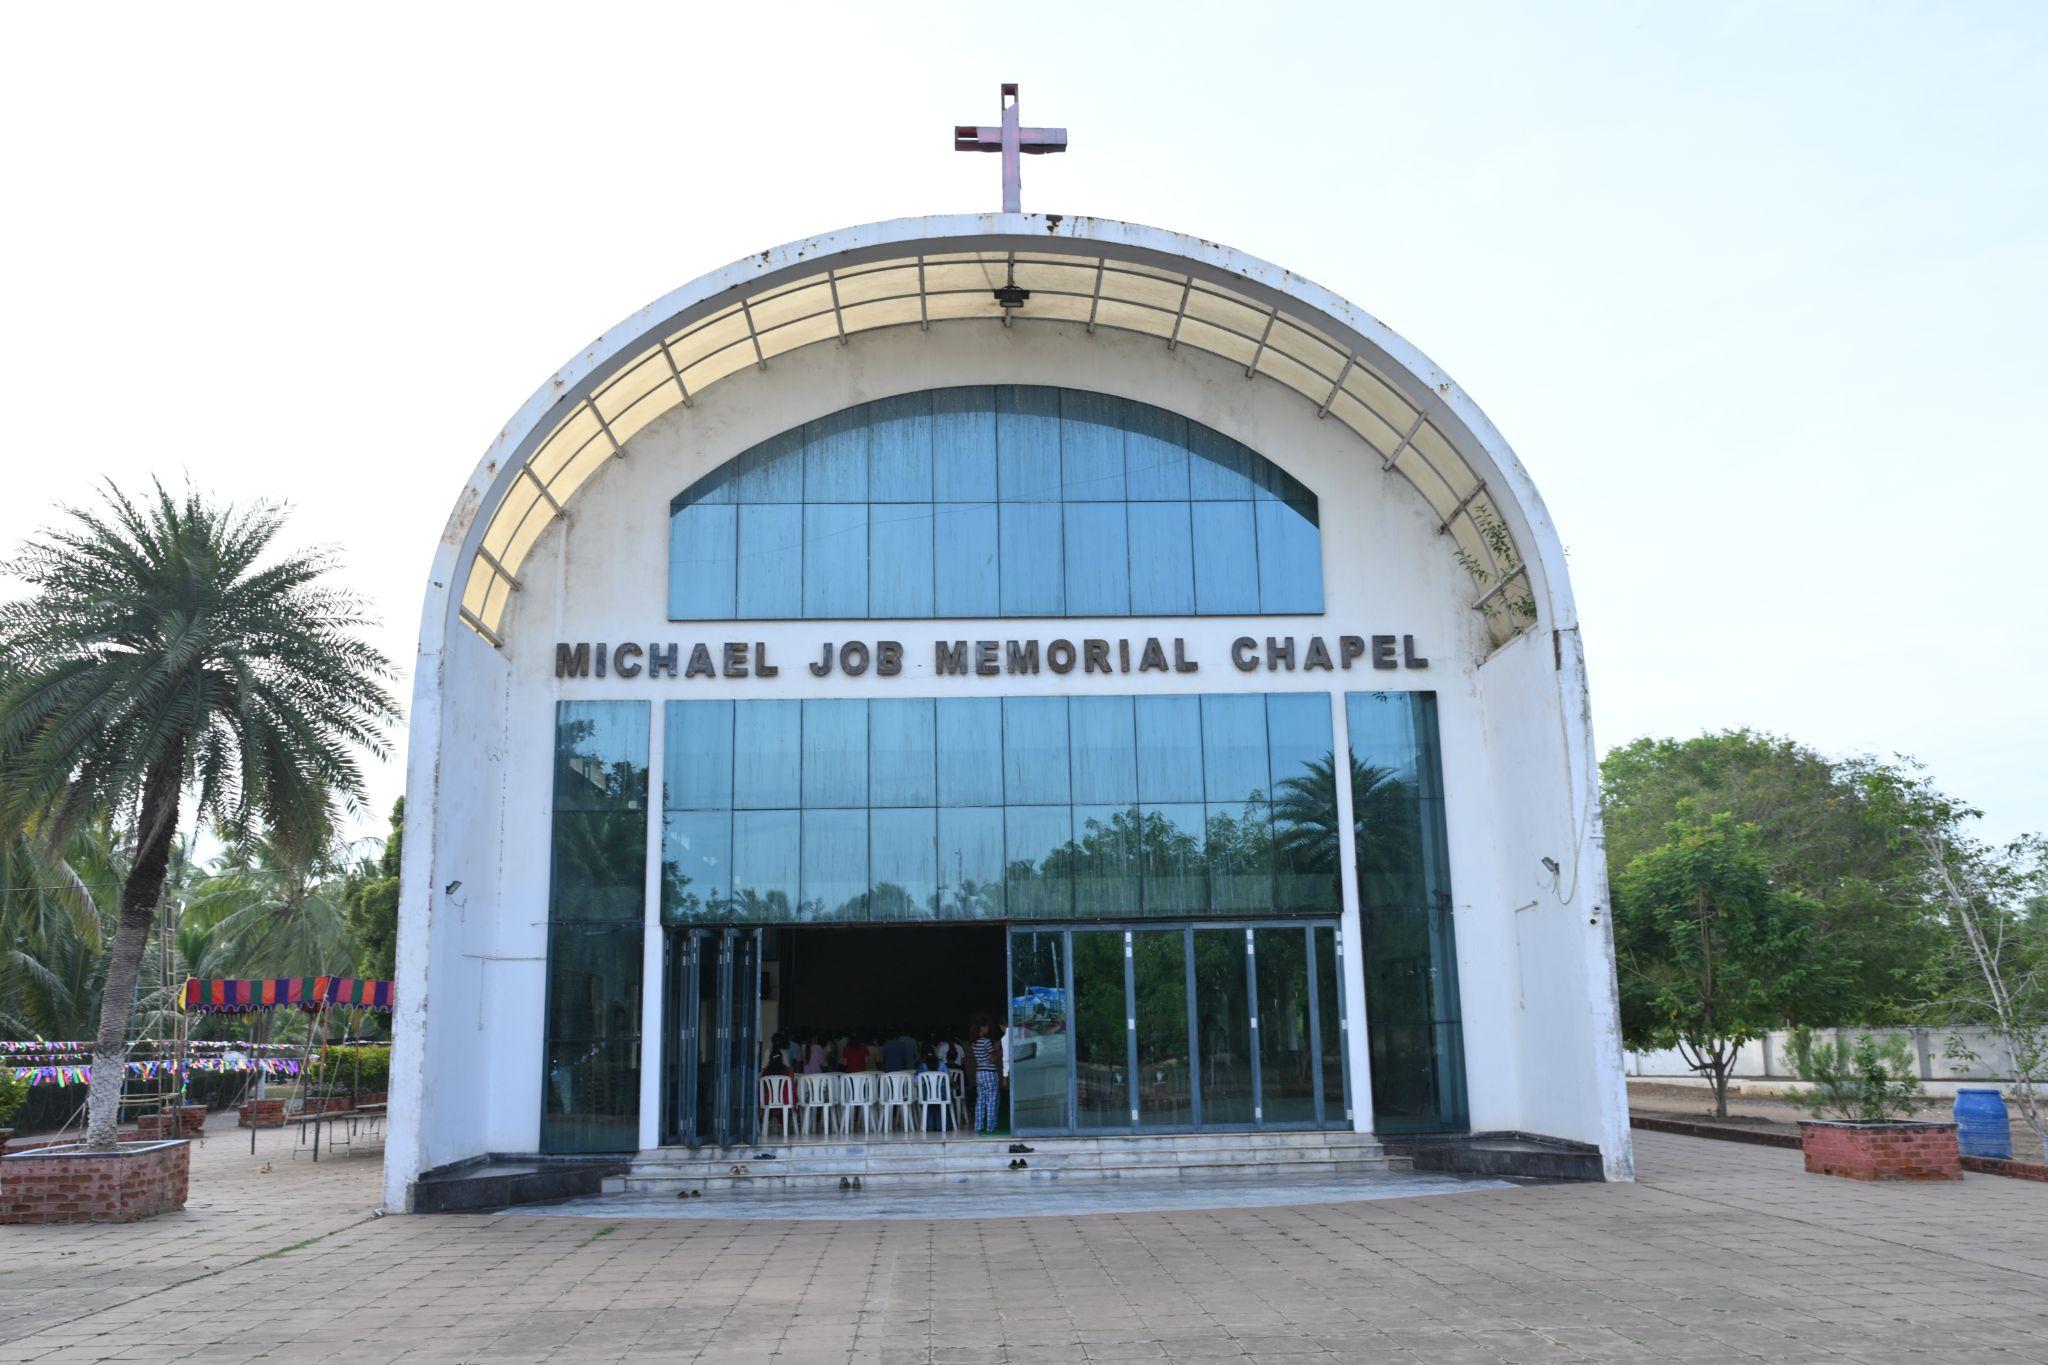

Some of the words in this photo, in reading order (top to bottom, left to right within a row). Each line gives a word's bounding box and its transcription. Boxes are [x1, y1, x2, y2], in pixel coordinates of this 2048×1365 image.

[555, 641, 779, 678] MICHAEL
[809, 640, 904, 677] JOB
[935, 637, 1199, 676] MEMORIAL
[1231, 634, 1429, 672] CHAPEL
